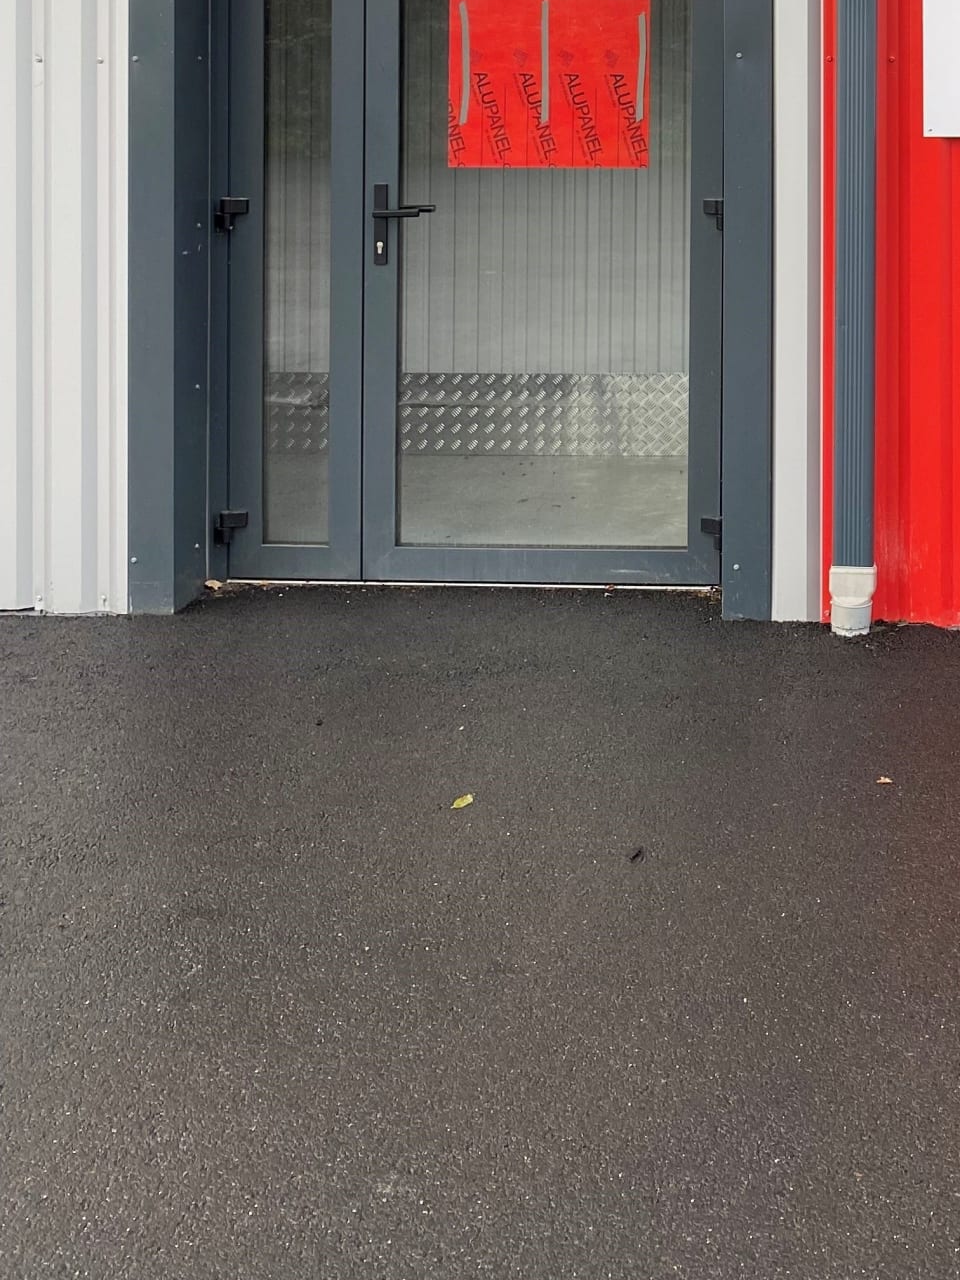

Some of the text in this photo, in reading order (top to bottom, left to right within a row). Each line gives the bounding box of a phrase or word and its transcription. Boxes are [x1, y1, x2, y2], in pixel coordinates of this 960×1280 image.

[473, 72, 512, 160] ALUPANEL
[564, 73, 603, 161] ALUPANEL
[609, 73, 649, 161] ALUPANEL
